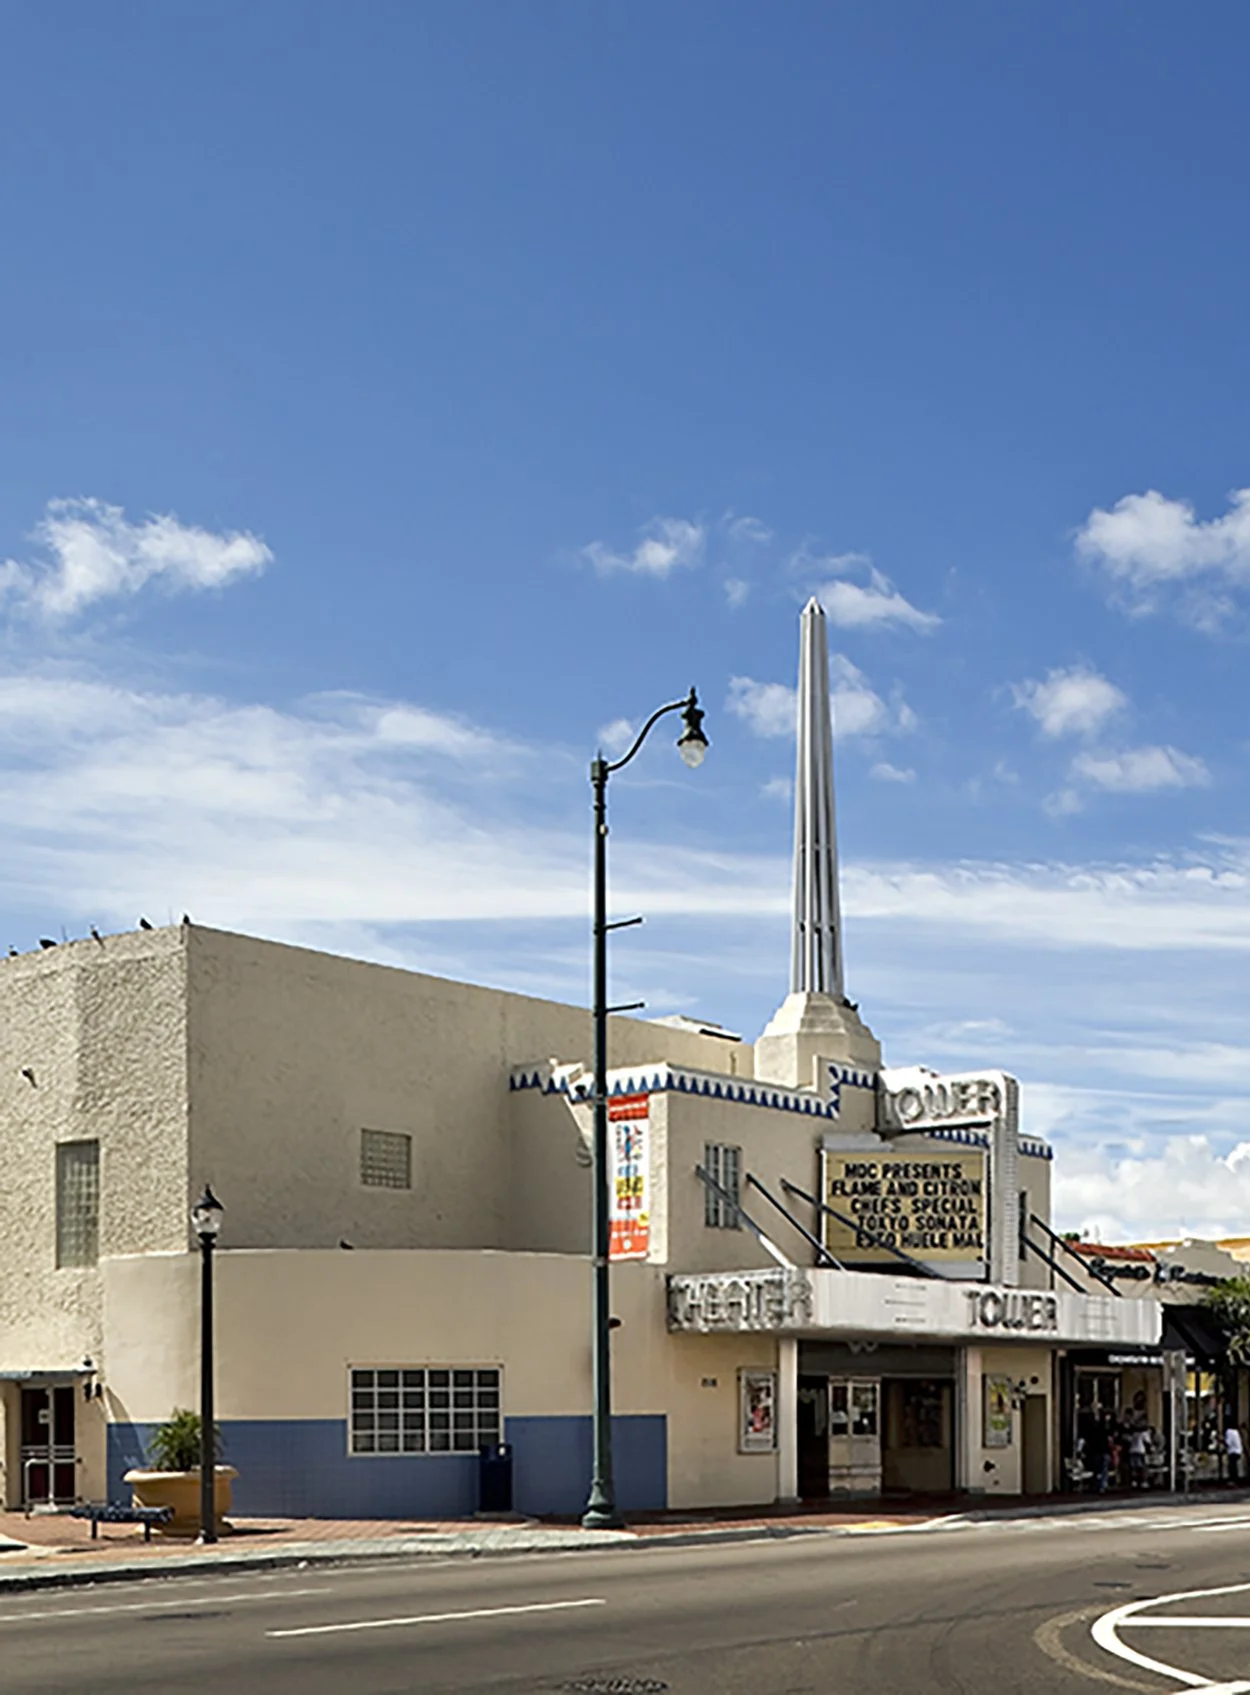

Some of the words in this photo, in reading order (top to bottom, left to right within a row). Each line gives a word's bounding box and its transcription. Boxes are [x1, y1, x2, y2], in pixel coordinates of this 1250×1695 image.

[882, 1079, 1002, 1125] TOWER
[882, 1163, 963, 1179] PRESENTS
[831, 1180, 882, 1197] FLAME
[886, 1181, 919, 1196] AND
[922, 1180, 982, 1196] CITRON
[911, 1198, 977, 1214] SPECIAL
[857, 1215, 909, 1231] TOKYO
[915, 1215, 979, 1231] SONATA
[963, 1290, 1059, 1330] TOWER
